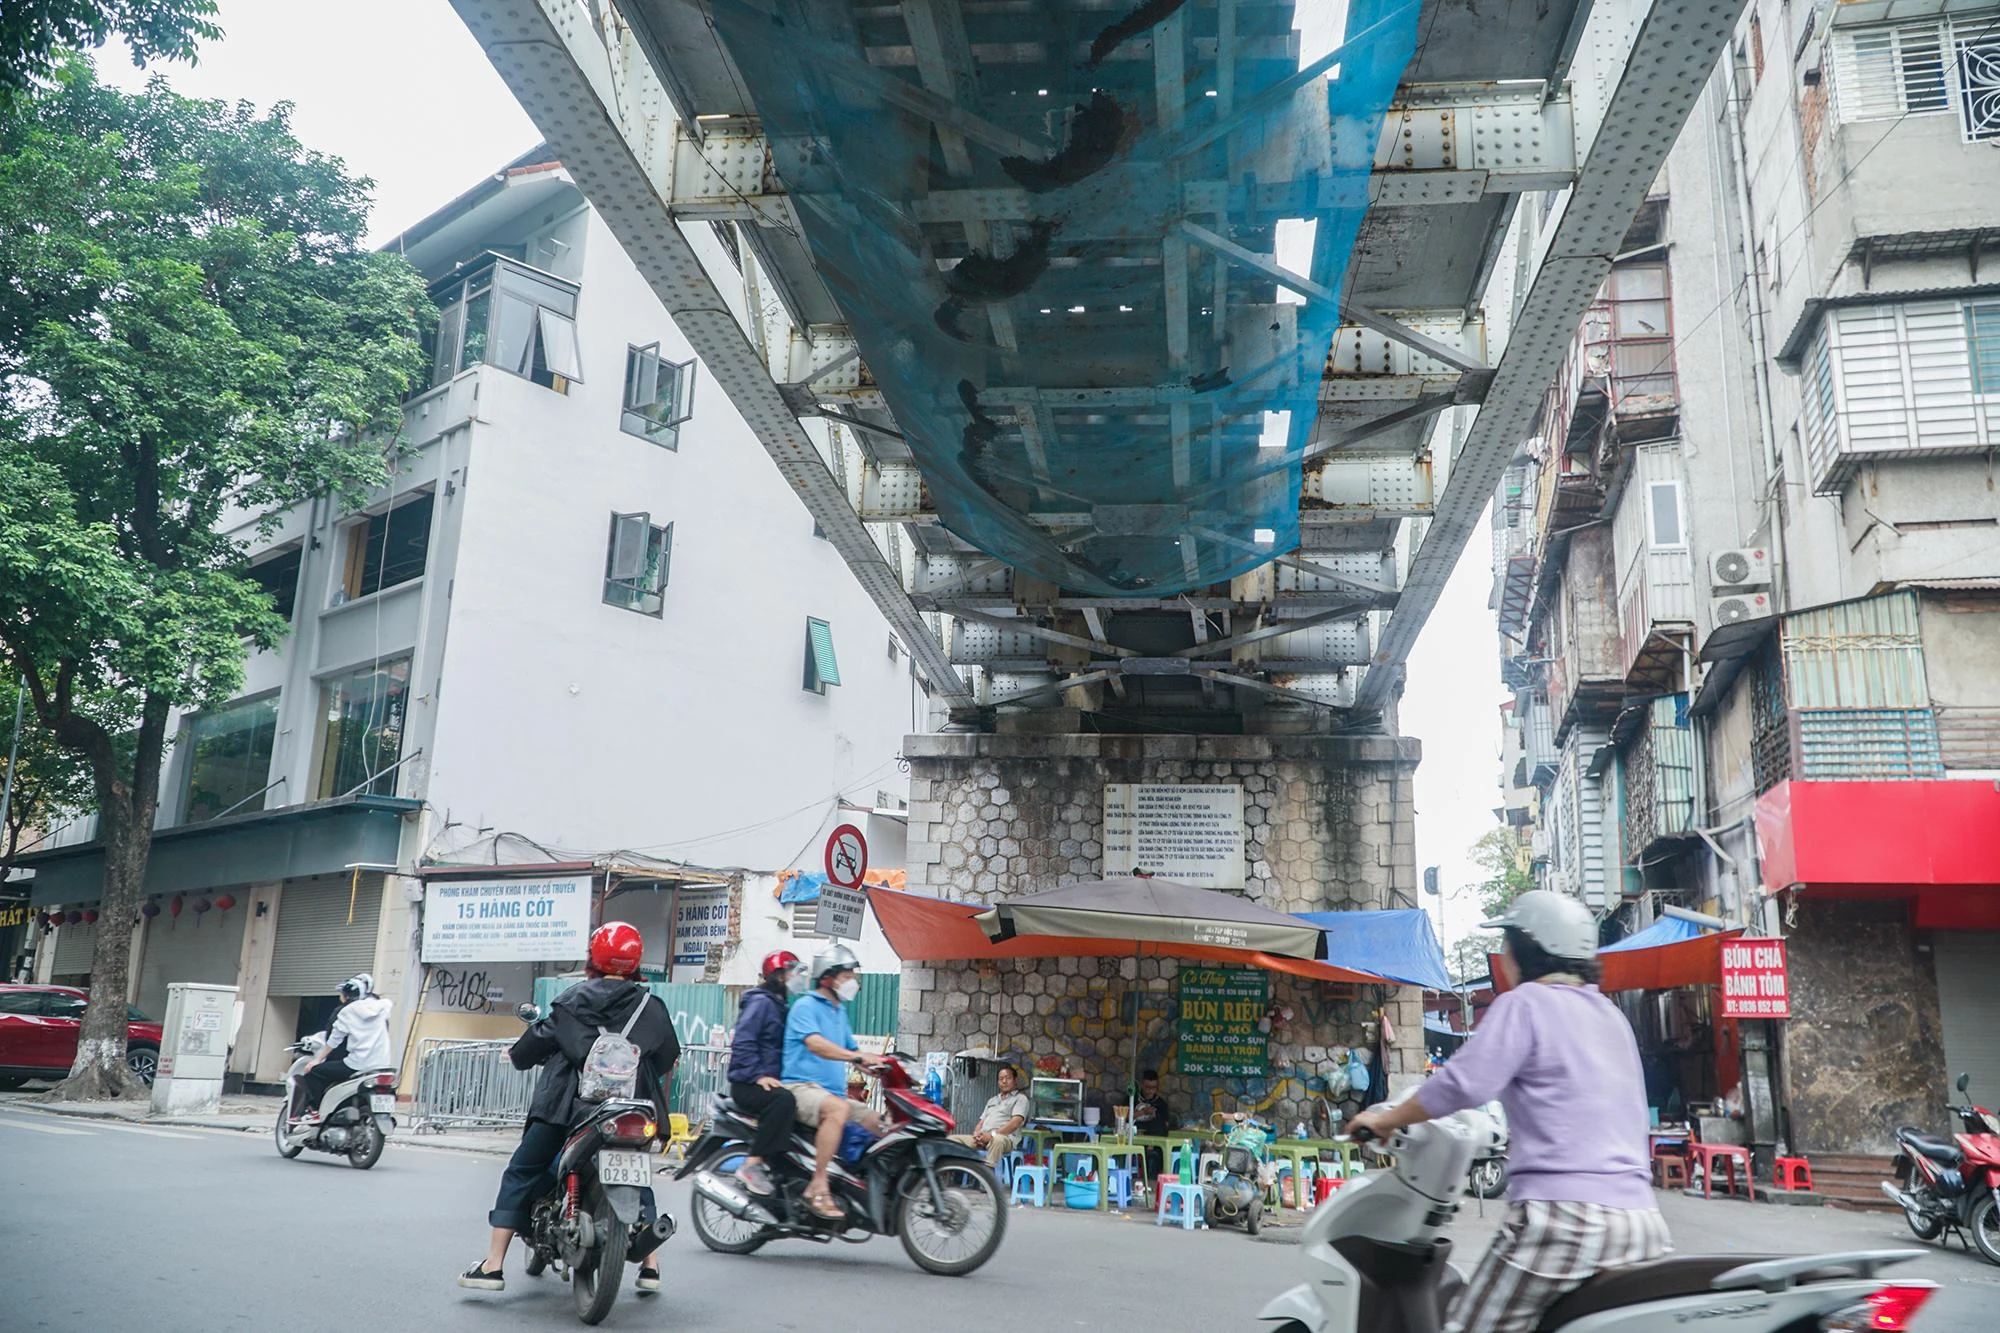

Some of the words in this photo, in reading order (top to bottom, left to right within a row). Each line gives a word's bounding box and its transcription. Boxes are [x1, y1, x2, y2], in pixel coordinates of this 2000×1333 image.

[505, 884, 522, 895] KHOA
[528, 883, 540, 895] HỌC
[458, 903, 475, 919] 15
[480, 898, 520, 918] HÀNG
[526, 897, 554, 917] CÓT
[686, 904, 710, 921] HÀNG
[712, 902, 728, 920] CÓT
[676, 924, 691, 937] HÁM
[1723, 944, 1752, 969] BÚN
[1754, 941, 1783, 968] CHẢ
[1725, 971, 1757, 996] BÁNH
[1758, 971, 1785, 996] TÔM
[1182, 995, 1219, 1020] BÚN
[1223, 997, 1264, 1022] RIÊU
[1193, 1022, 1224, 1033] TÓP
[1201, 1034, 1215, 1042] BÒ
[1223, 1034, 1239, 1043] GIÒ
[1247, 1037, 1266, 1045] SỤN
[1184, 1064, 1204, 1072] 20K
[1213, 1065, 1233, 1073] 30K
[1242, 1066, 1261, 1074] 35K
[608, 1153, 643, 1168] 29-F1
[604, 1168, 648, 1184] 028.31
